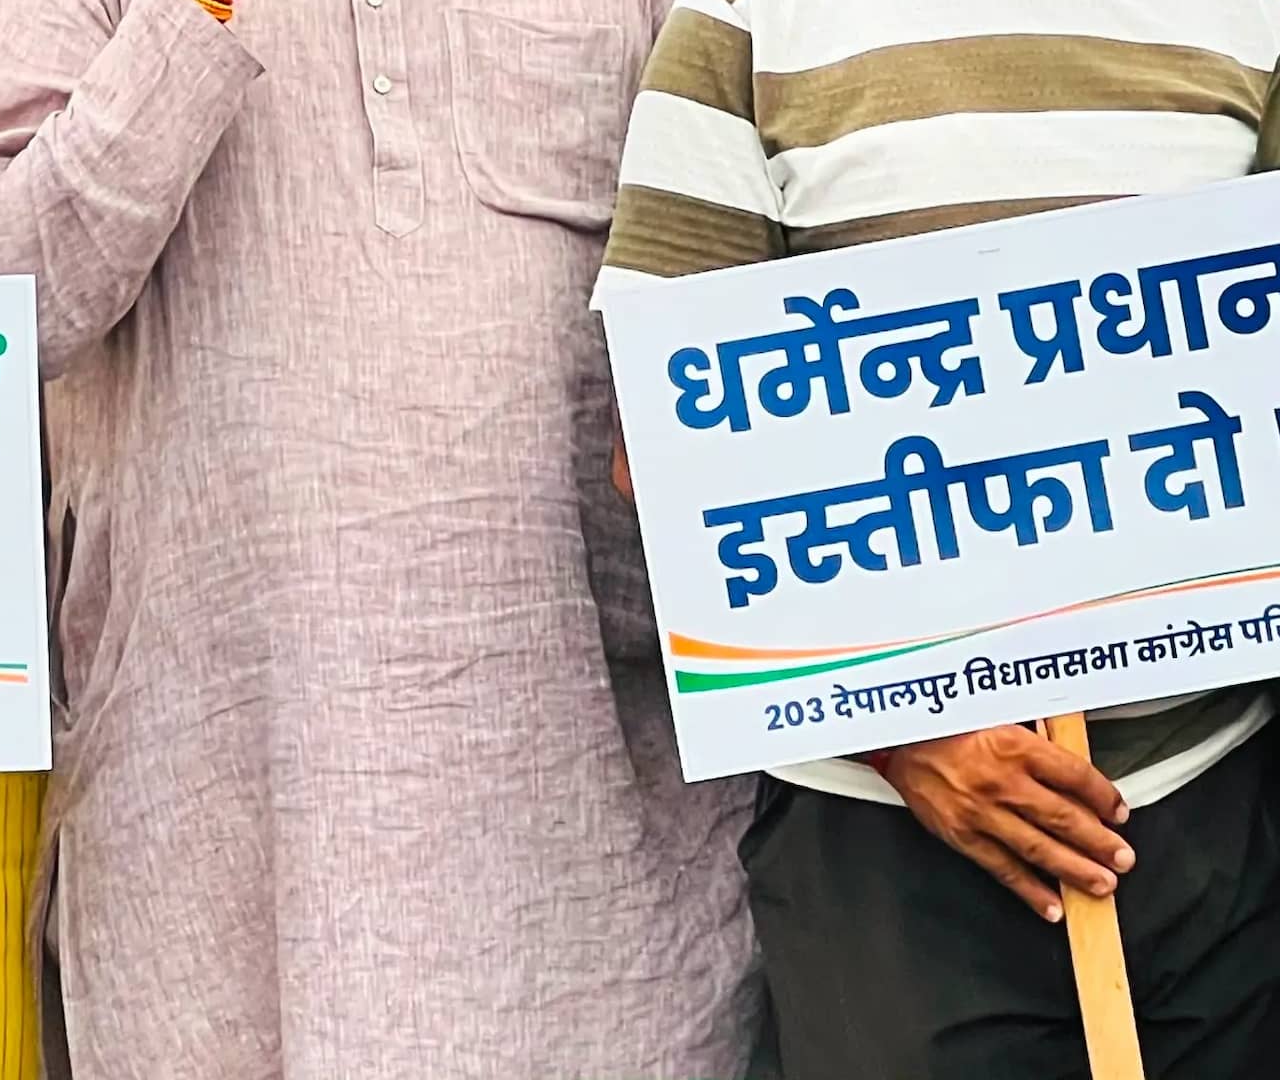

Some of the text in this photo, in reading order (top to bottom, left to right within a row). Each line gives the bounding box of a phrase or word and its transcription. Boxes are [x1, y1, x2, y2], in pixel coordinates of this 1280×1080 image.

[667, 287, 986, 433] धर्मेन्द्र
[702, 434, 1115, 610] इस्तीफा
[1127, 390, 1246, 521] दो
[764, 697, 825, 732] 203
[830, 671, 959, 719] देपालपुर
[962, 641, 1129, 696] विधानसभा
[1133, 620, 1234, 663] कांग्रेस
